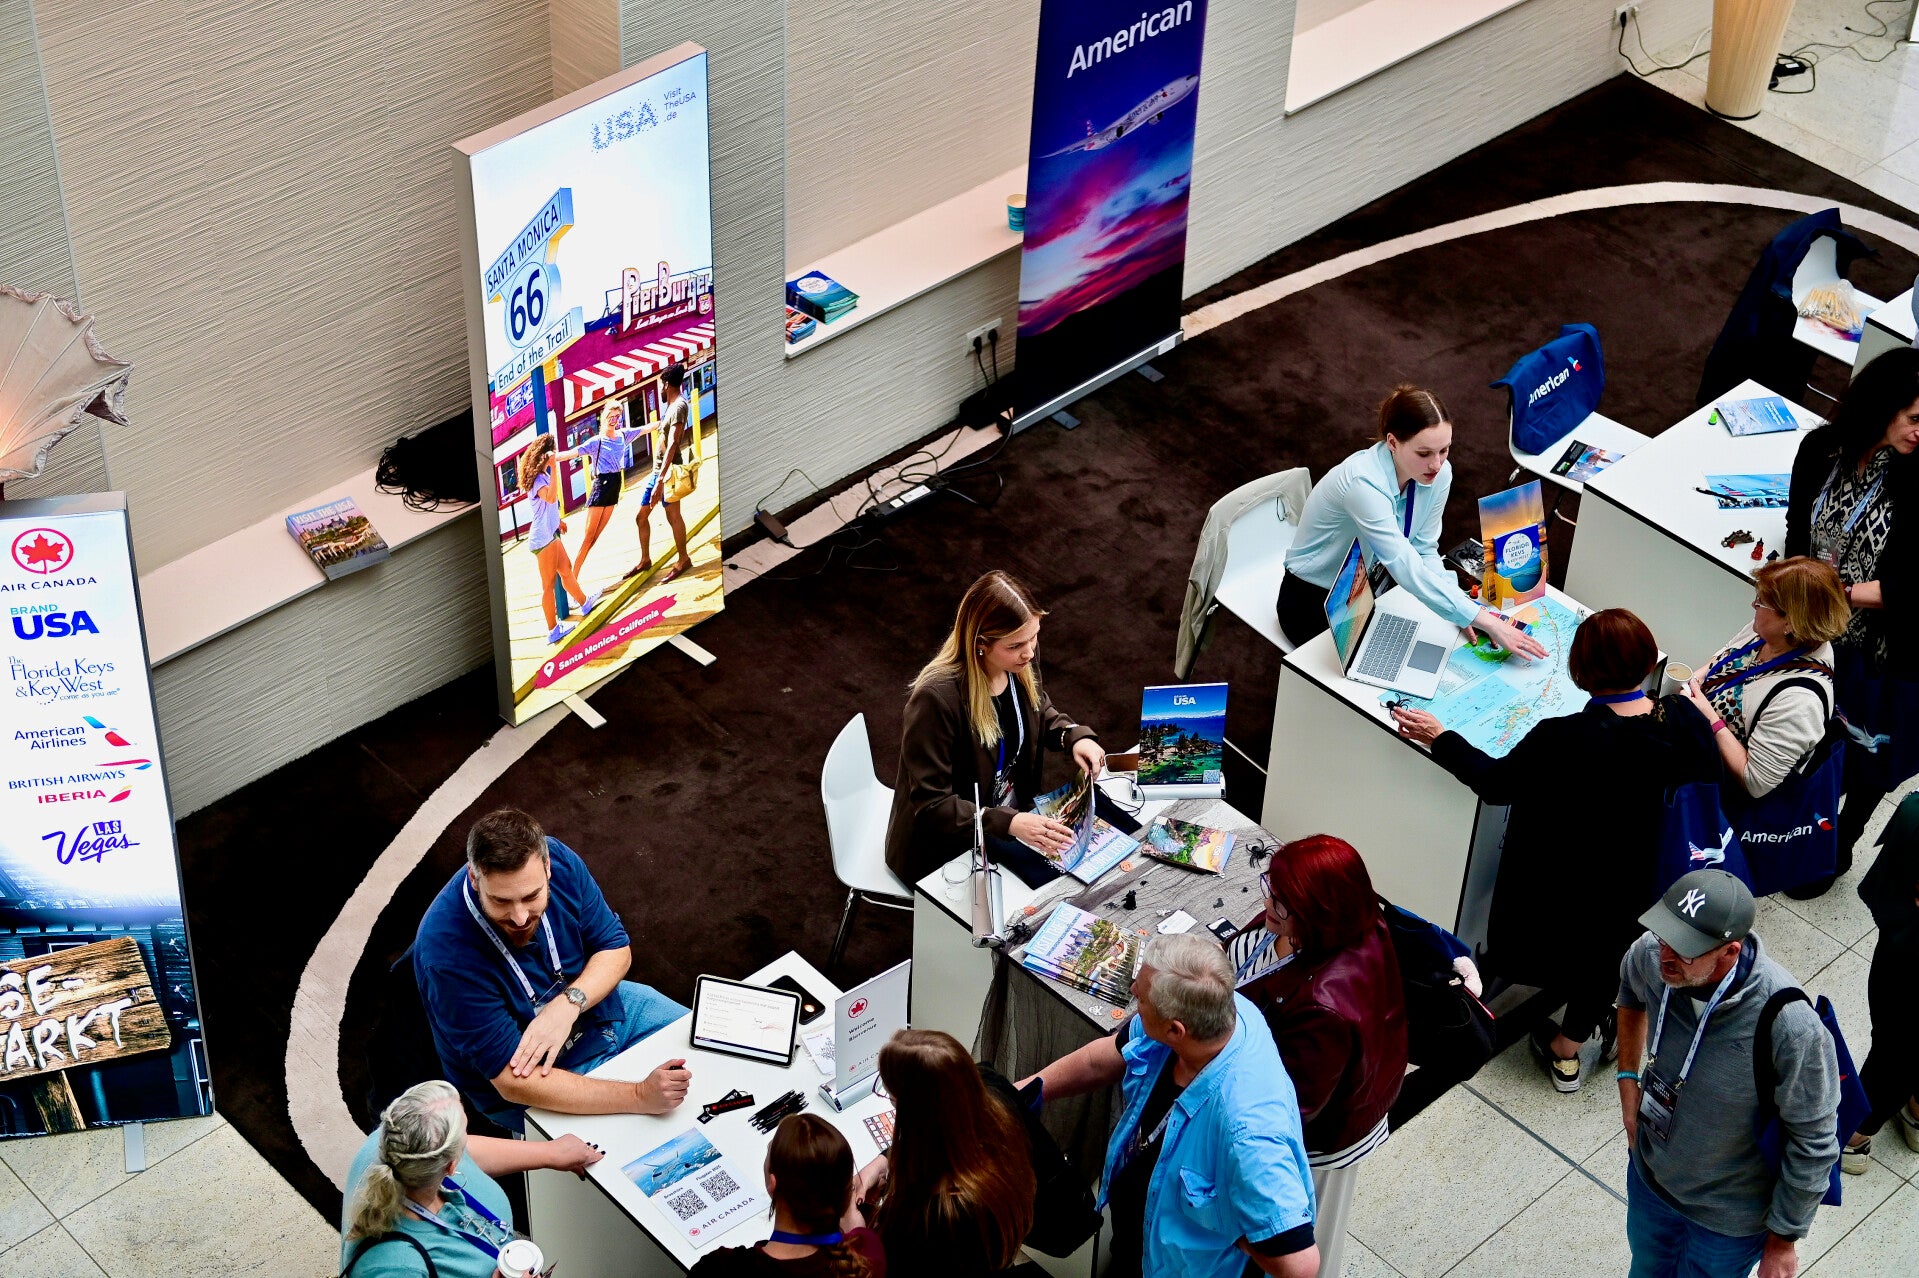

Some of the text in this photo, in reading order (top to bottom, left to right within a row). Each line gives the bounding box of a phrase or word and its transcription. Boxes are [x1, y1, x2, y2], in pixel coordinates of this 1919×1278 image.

[1067, 0, 1193, 78] American
[664, 87, 681, 100] Visit
[664, 92, 697, 111] TheUSA
[592, 101, 658, 151] USA
[487, 203, 559, 293] SANTA MONICA
[509, 268, 544, 341] 66
[622, 261, 711, 332] PierBurger
[498, 319, 569, 389] End of the Trail
[293, 511, 319, 524] VISIT
[319, 505, 335, 518] THE
[335, 501, 354, 515] USA
[1505, 542, 1530, 554] FLORIDA
[1, 577, 97, 592] AIR CANADA
[10, 604, 58, 615] BRAND
[12, 610, 100, 640] USA
[558, 609, 660, 671] Santa Monica, California
[11, 657, 115, 680] Florida Keys
[1173, 695, 1196, 706] USA
[14, 726, 85, 741] American
[30, 737, 86, 750] Airlines
[8, 770, 126, 790] BRITISH AIRWAYS
[38, 790, 107, 804] IBERIA
[94, 820, 121, 835] LAS
[1741, 825, 1812, 843] American
[42, 825, 141, 865] Vegas
[1220, 928, 1237, 938] USA
[0, 997, 132, 1071] ARKT
[848, 1017, 875, 1034] Welcome
[702, 1196, 755, 1229] AIR CANADA
